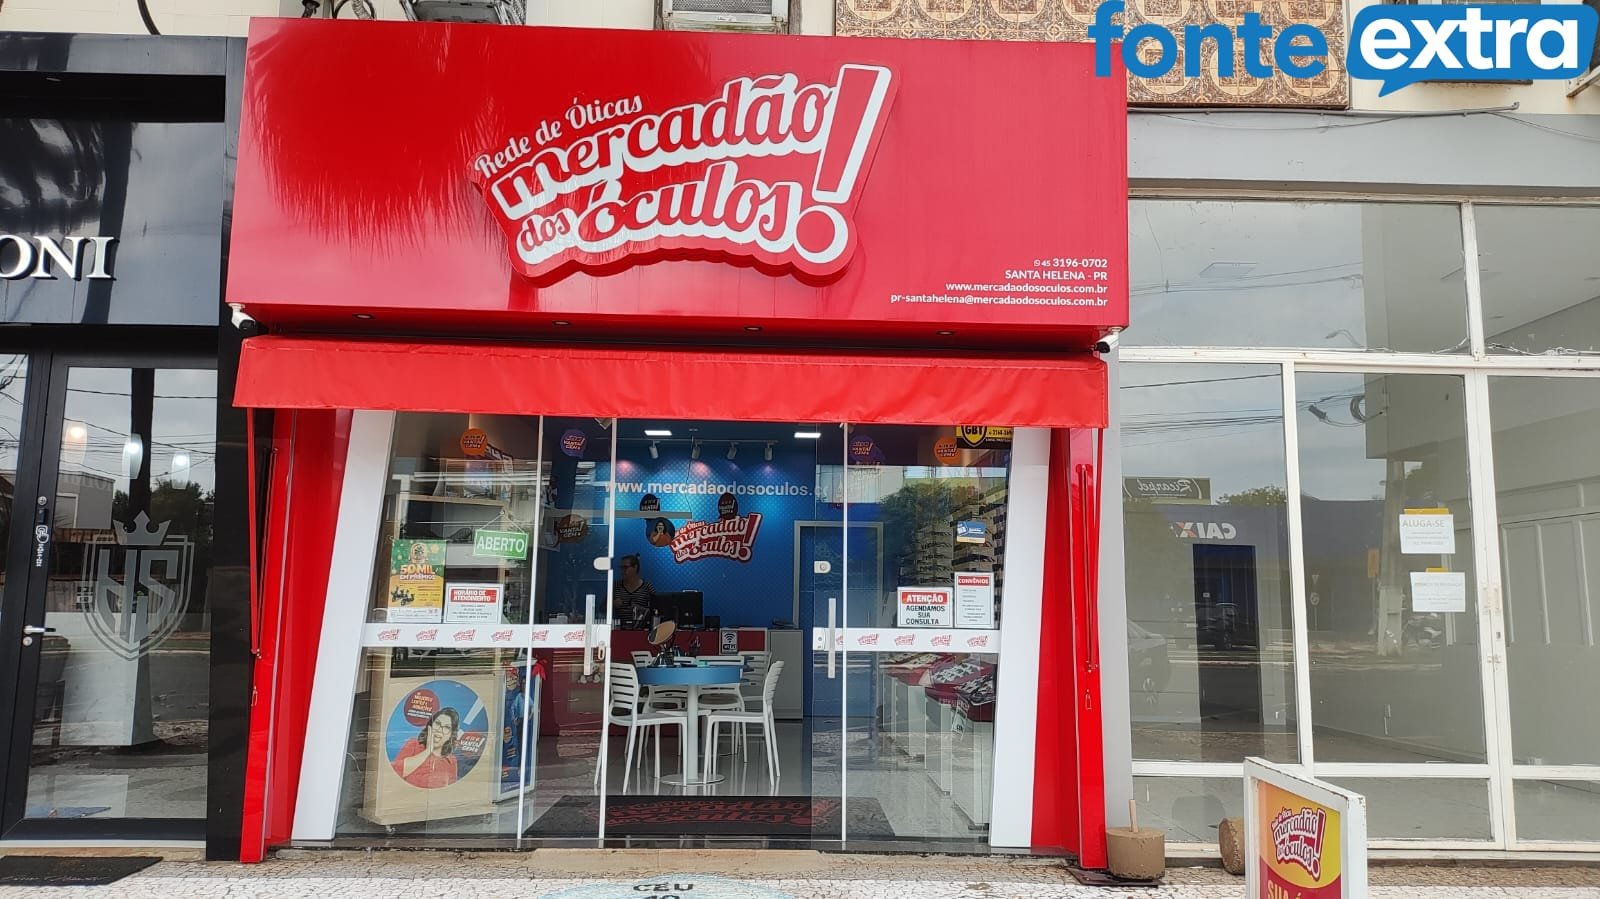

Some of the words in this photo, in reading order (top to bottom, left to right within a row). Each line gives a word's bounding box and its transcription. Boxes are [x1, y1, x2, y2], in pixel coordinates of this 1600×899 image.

[474, 136, 532, 179] Rede
[535, 119, 563, 146] de
[565, 95, 643, 130] Óticas
[519, 212, 571, 254] dos
[1052, 258, 1108, 268] 3196-0702
[1005, 269, 1041, 279] SANTA
[1042, 270, 1086, 280] HELENA
[1093, 271, 1108, 281] PR
[946, 282, 1108, 294] www.mercadaodosoculos.com.br
[890, 294, 1108, 307] pr-santahelena@mercadaodosoculos.com.br
[1402, 519, 1445, 528] ALUGA-SE
[476, 535, 525, 553] ABERTO
[906, 592, 944, 604] ATENÇÃO
